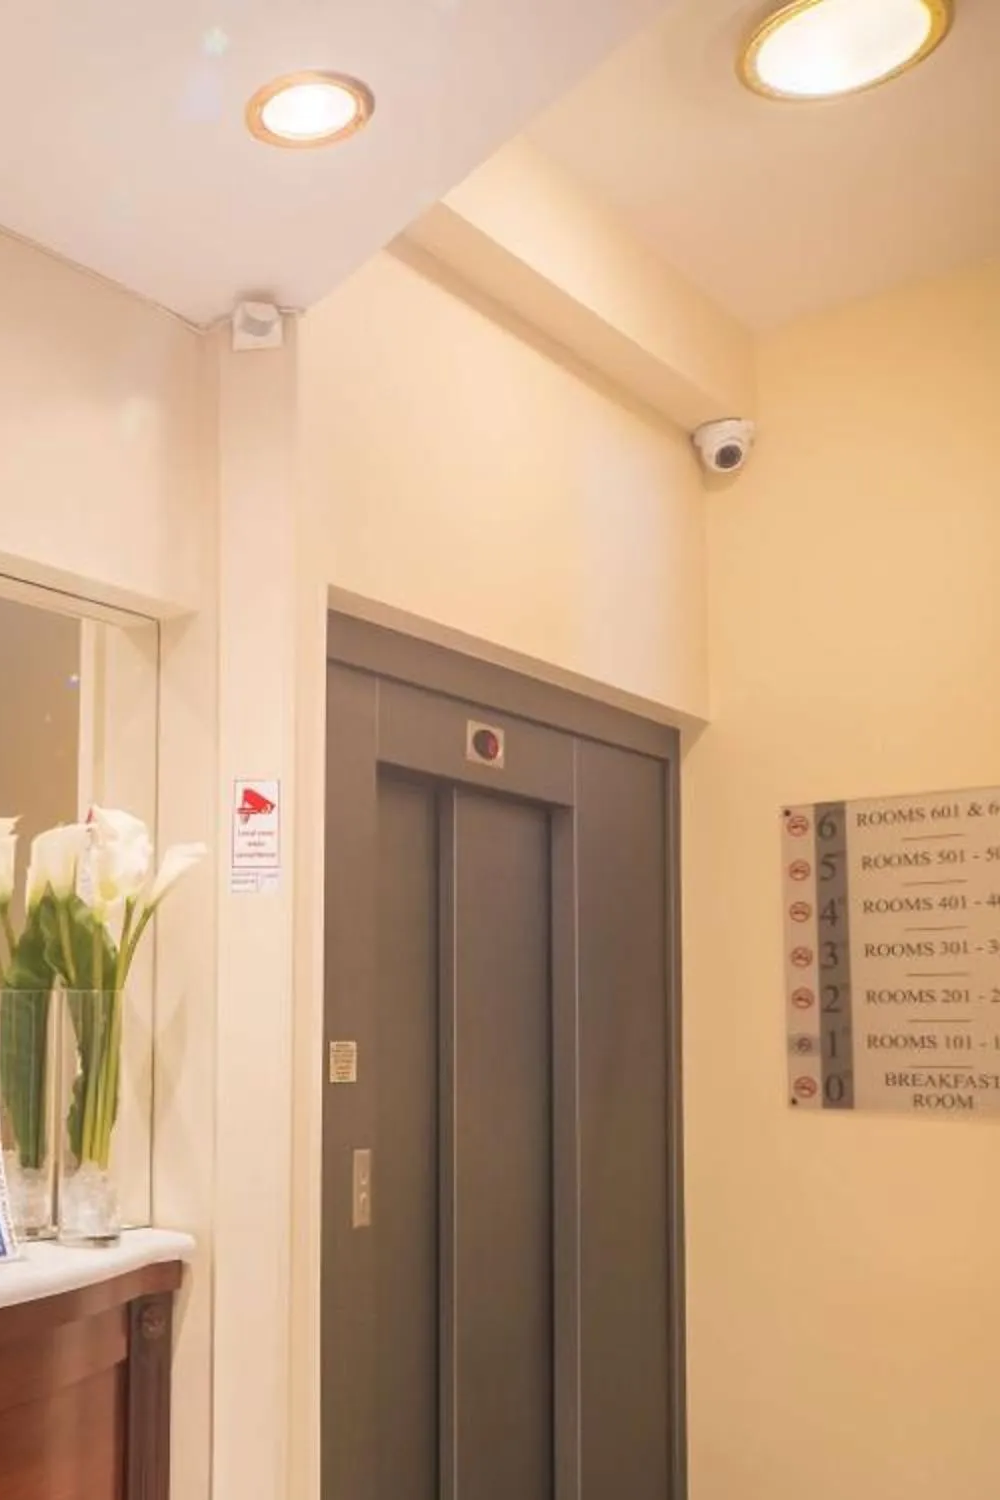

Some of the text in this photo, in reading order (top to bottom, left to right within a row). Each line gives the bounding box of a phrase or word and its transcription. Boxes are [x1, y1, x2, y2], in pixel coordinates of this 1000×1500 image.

[817, 812, 837, 841] 6
[857, 806, 926, 827] ROOMS
[931, 803, 960, 820] 601
[820, 853, 837, 882] 5
[862, 851, 932, 871] ROOMS
[936, 848, 966, 866] 501
[819, 898, 840, 928] 4
[863, 896, 935, 914] ROOMS
[938, 894, 967, 911] 401
[820, 940, 839, 969] 3
[864, 940, 936, 958] ROOMS
[939, 939, 969, 957] 301
[822, 984, 841, 1014] 2
[866, 988, 937, 1006] ROOMS
[941, 988, 970, 1004] 201
[828, 1030, 837, 1059] 1
[866, 1033, 938, 1051] ROOMS
[944, 1034, 972, 1051] 101
[824, 1074, 844, 1103] 0
[884, 1070, 1000, 1090] BREAKFAST
[912, 1092, 975, 1111] ROOM
